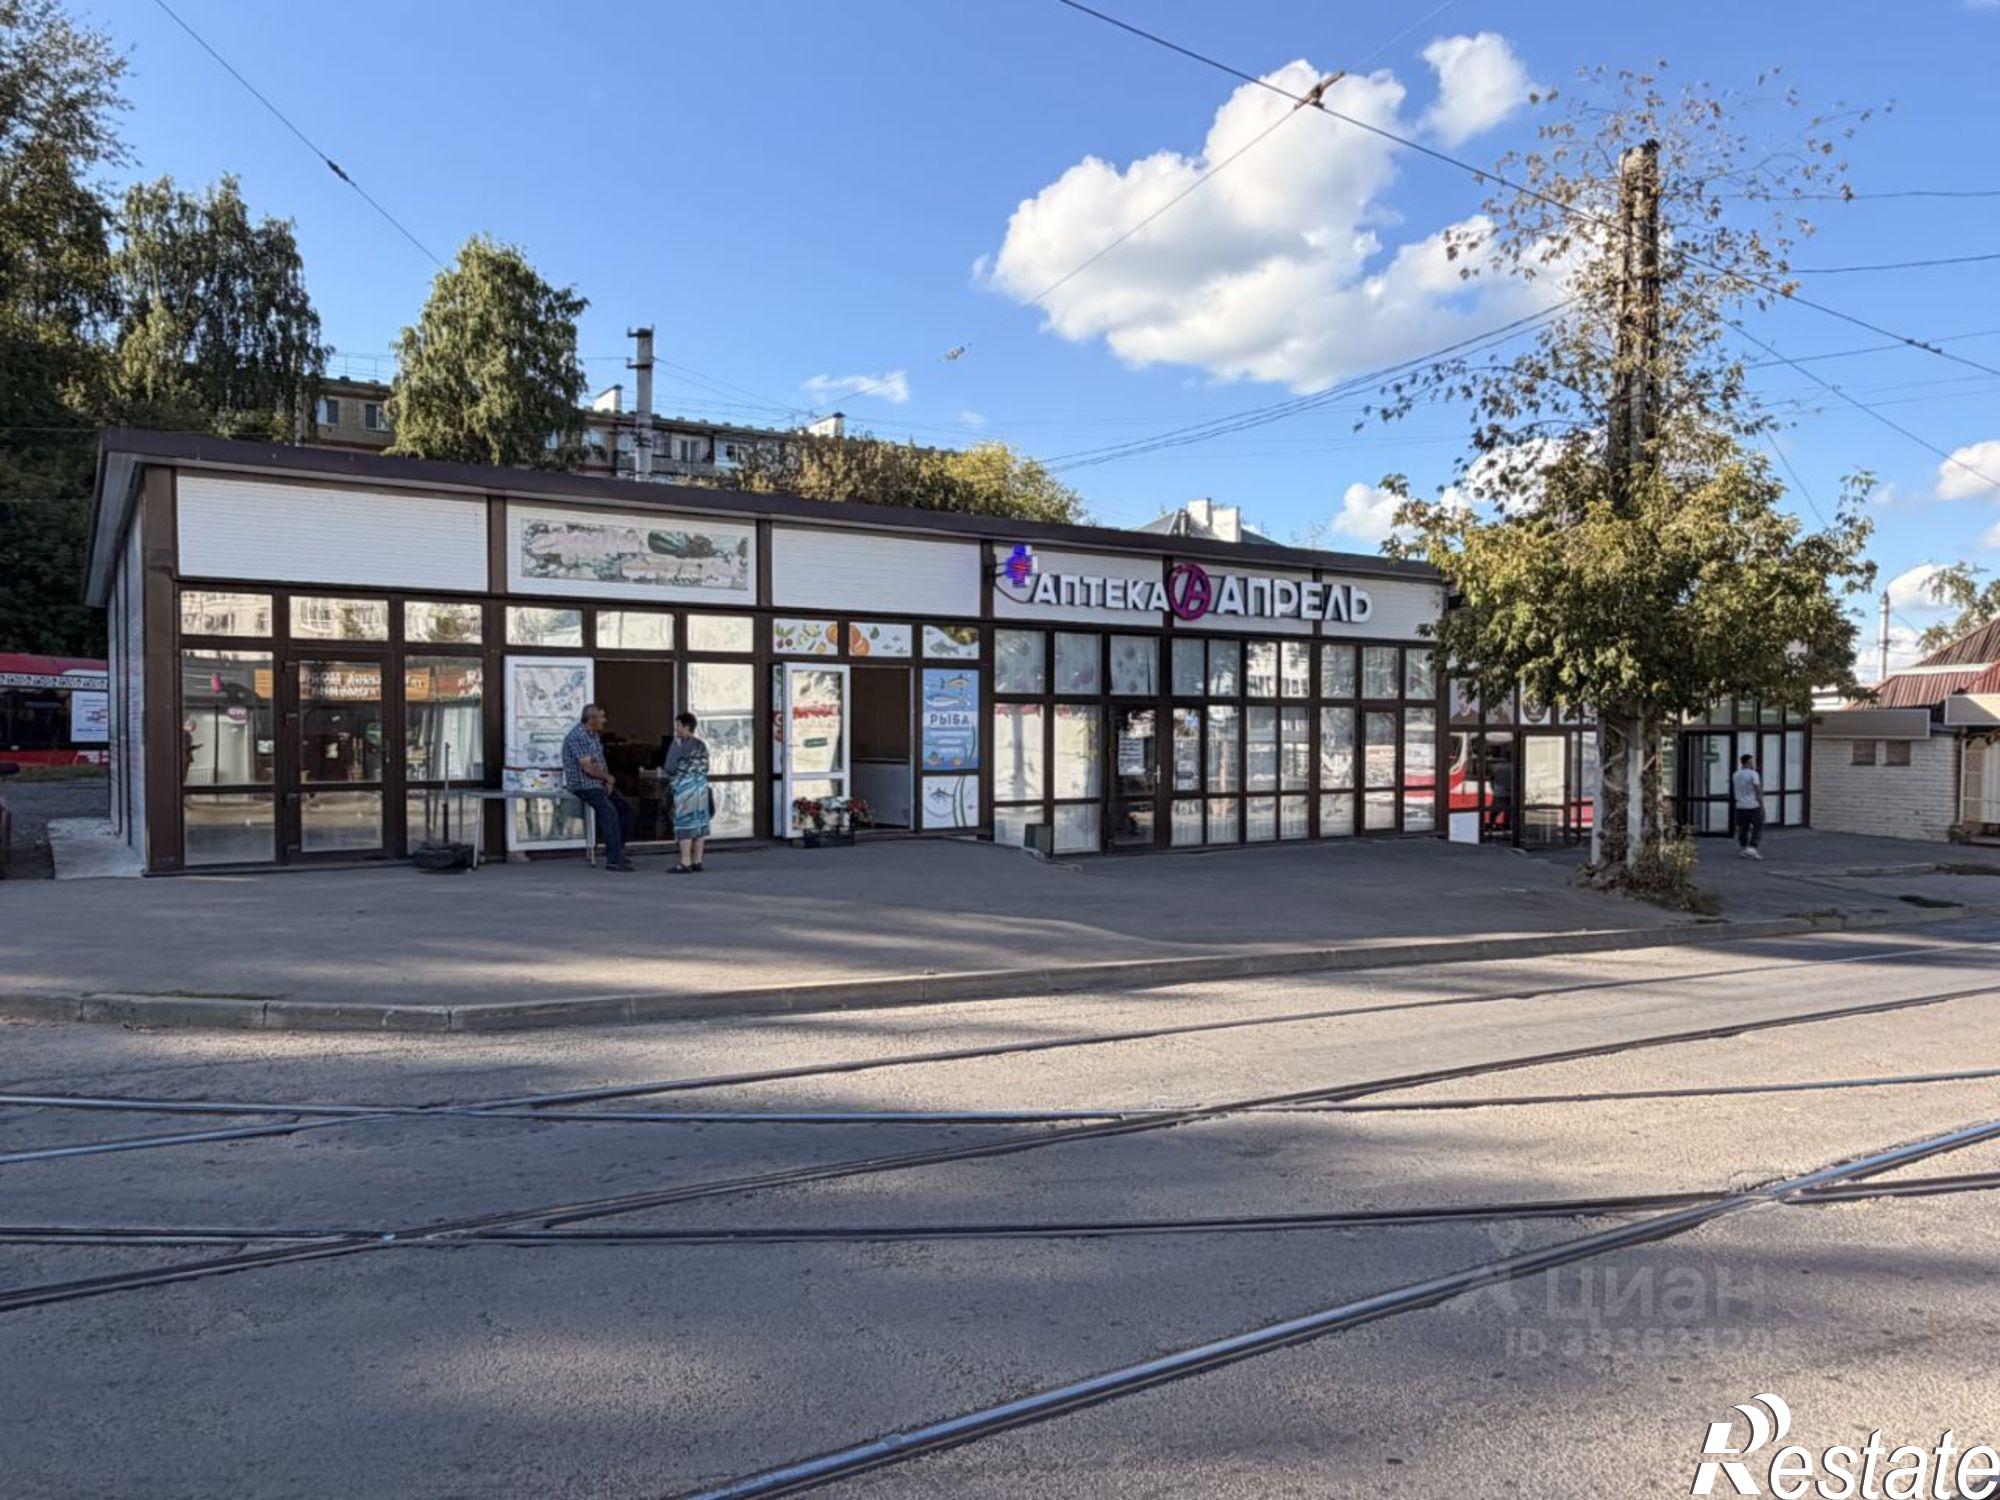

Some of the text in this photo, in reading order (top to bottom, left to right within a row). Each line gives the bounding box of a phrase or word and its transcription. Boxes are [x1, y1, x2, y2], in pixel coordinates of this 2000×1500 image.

[1033, 573, 1169, 612] АПТЕКА
[1216, 575, 1373, 623] АПРЕЛЬ
[930, 713, 970, 725] РЫБА
